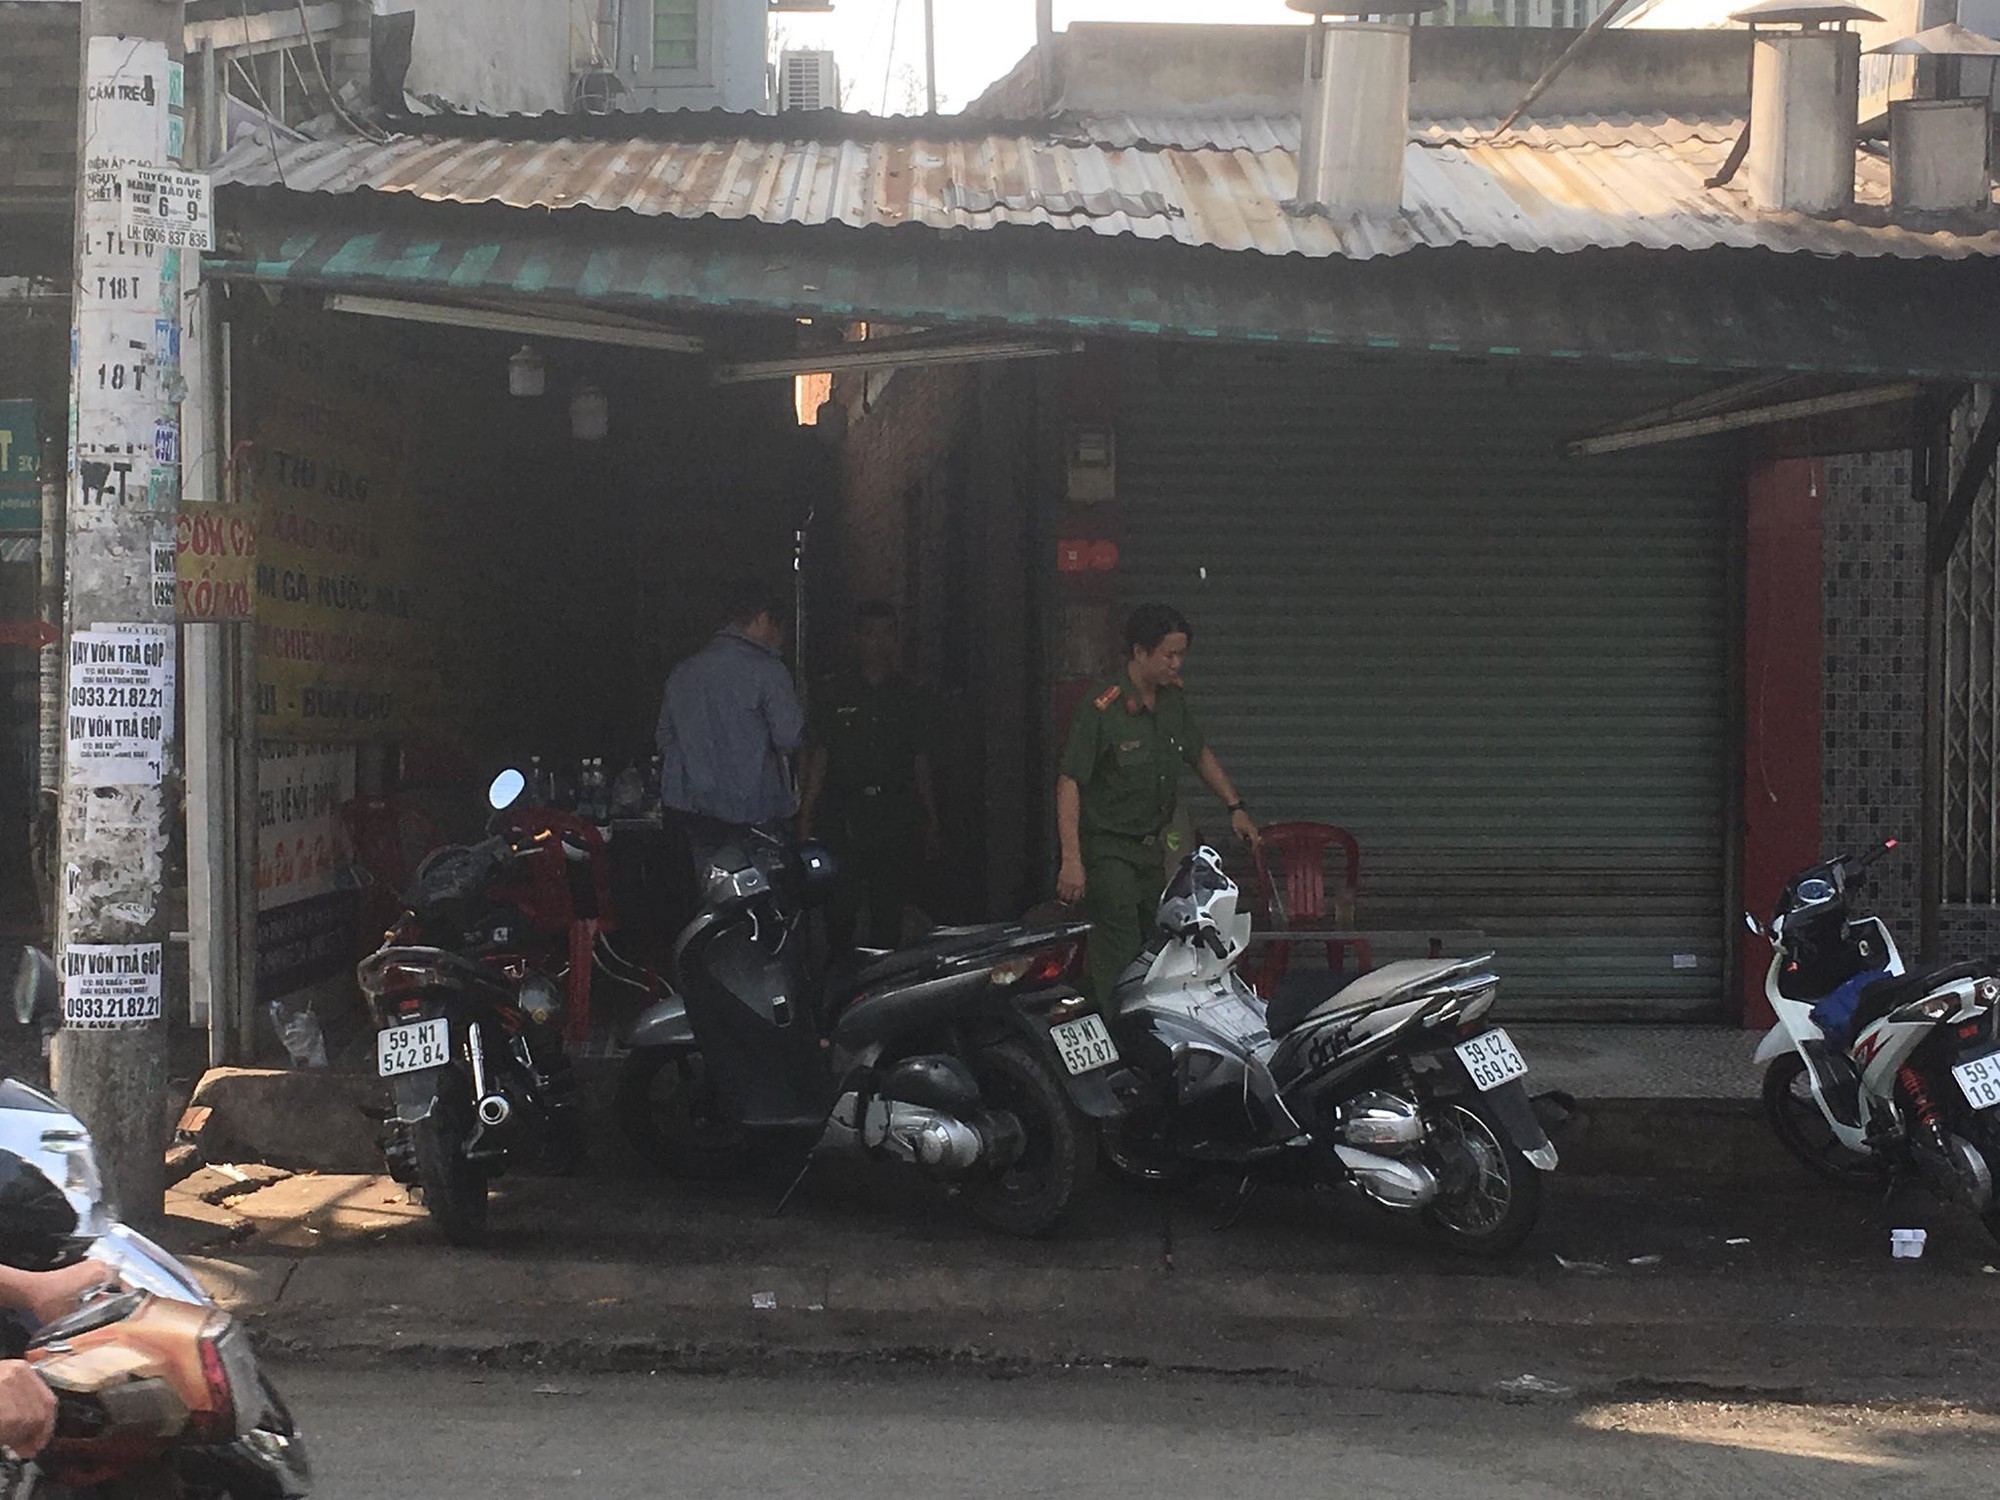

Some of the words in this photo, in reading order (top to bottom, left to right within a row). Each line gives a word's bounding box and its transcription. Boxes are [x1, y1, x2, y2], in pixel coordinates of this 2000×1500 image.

[158, 197, 169, 217] 6
[186, 201, 198, 222] 9
[169, 231, 186, 246] 837
[189, 232, 208, 248] 836
[72, 641, 90, 666] VAY
[118, 638, 142, 665] TRẢ
[71, 687, 163, 708] 0933.21.82.21
[67, 952, 86, 977] VAY
[116, 948, 139, 974] TRẢ
[67, 996, 159, 1018] 0933.21.82.21
[389, 1024, 436, 1051] 59-N1
[1060, 1020, 1099, 1048] 59-N1
[384, 1043, 444, 1072] 542.84
[1065, 1039, 1112, 1070] 552.87
[1464, 1034, 1507, 1064] 59-C2
[1473, 1053, 1523, 1087] 669.43
